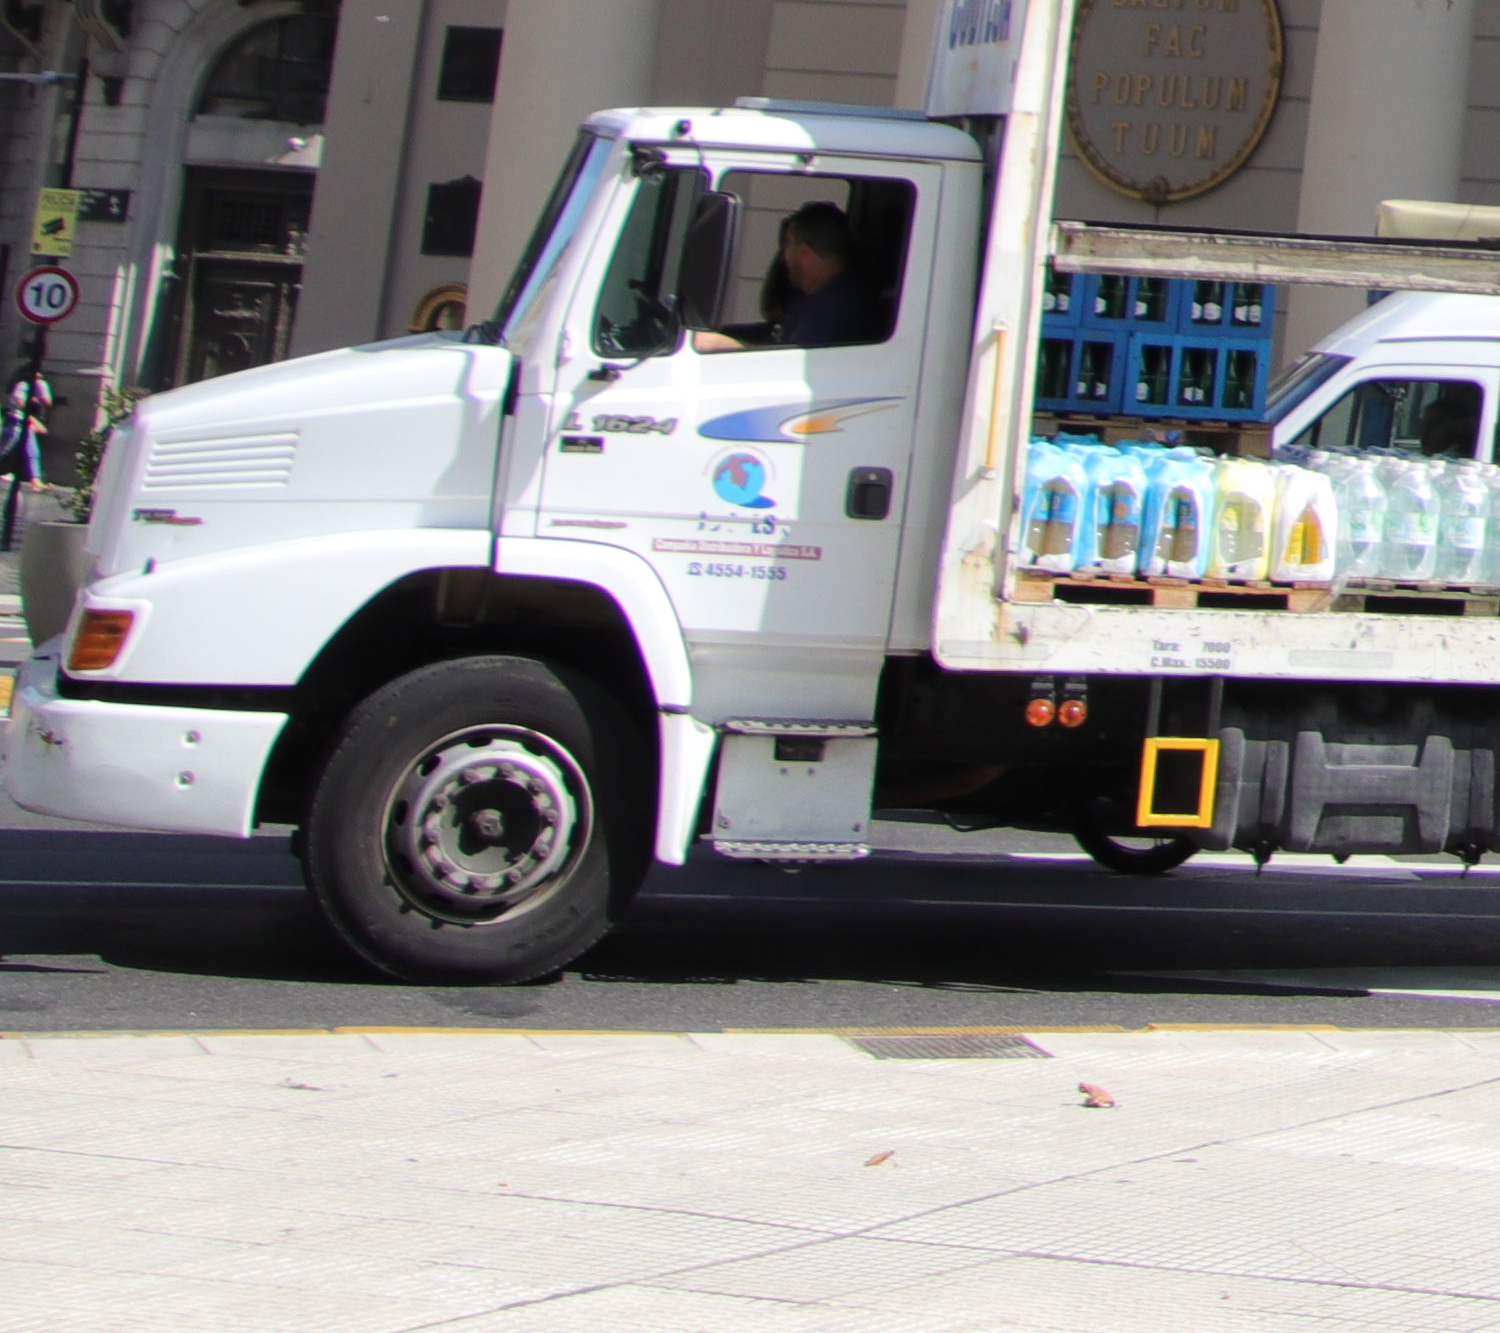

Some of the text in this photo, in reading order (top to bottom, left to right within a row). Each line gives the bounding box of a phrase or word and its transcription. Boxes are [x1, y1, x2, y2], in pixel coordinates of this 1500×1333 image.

[1142, 23, 1207, 58] FAC
[1091, 71, 1248, 111] POPULUM
[1111, 121, 1217, 159] TUUM
[30, 281, 67, 310] 10
[562, 411, 679, 436] L 1624
[705, 562, 787, 581] 4554-1555
